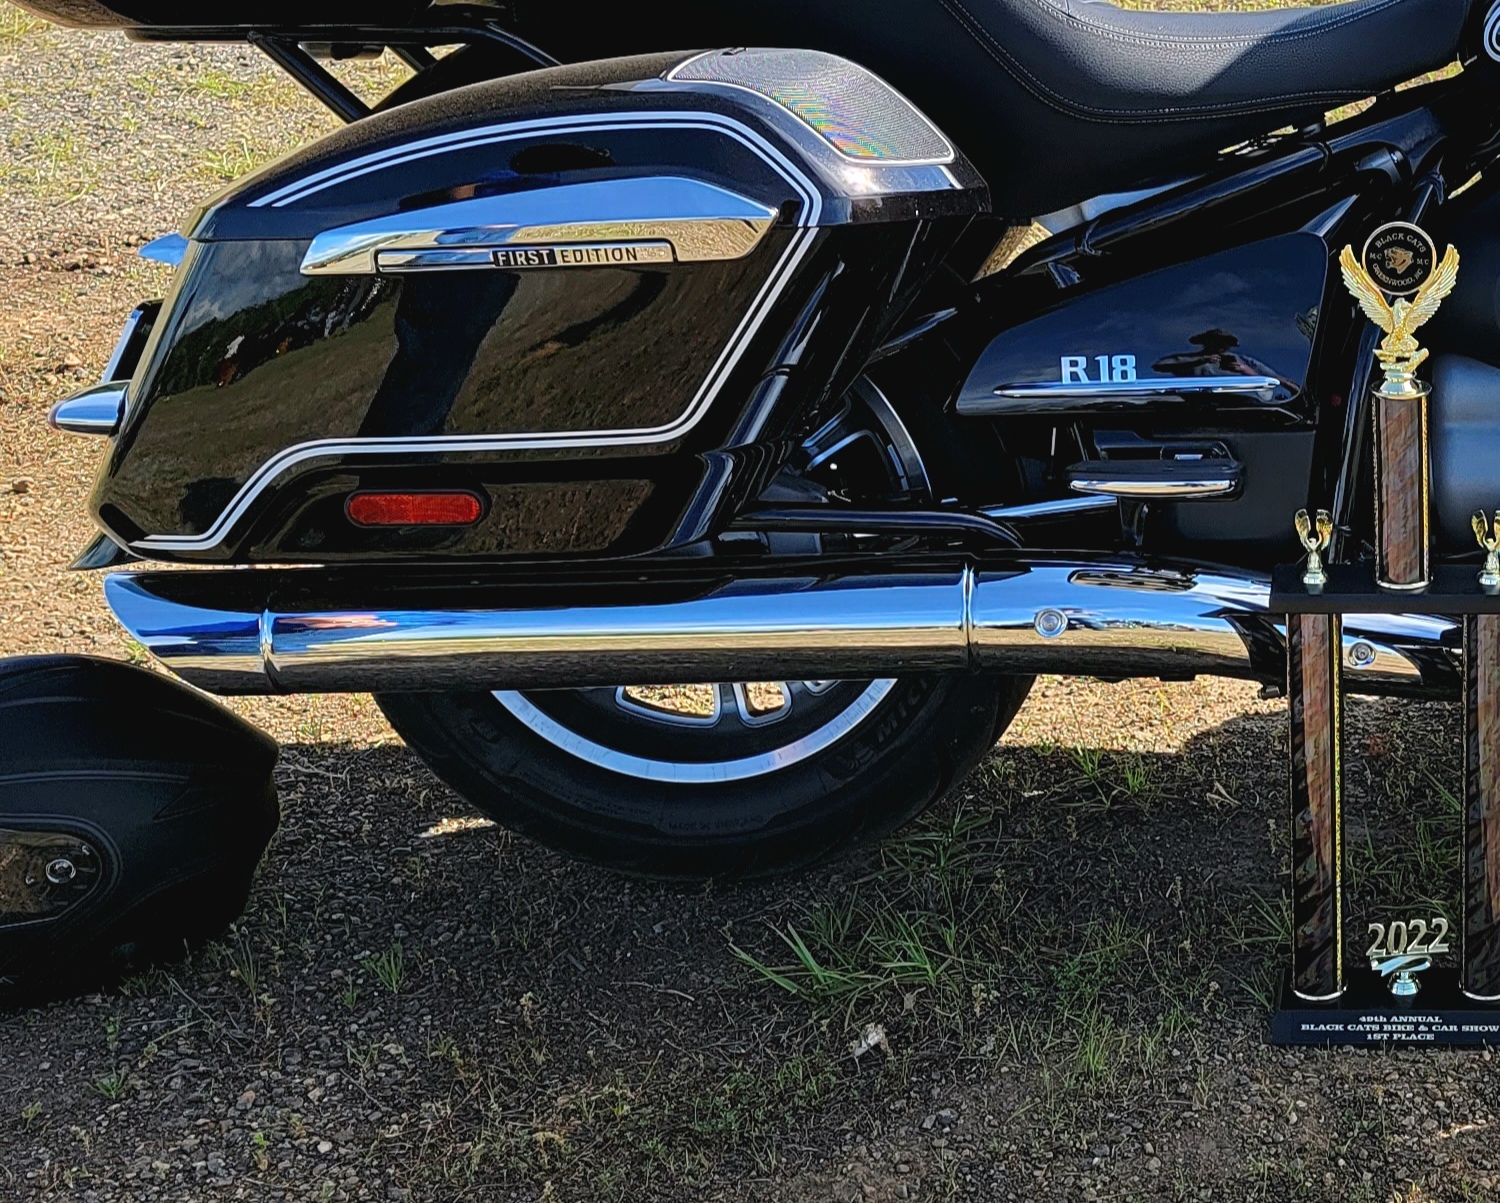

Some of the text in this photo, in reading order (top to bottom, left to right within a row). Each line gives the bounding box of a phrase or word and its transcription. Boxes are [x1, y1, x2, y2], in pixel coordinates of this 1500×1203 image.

[1375, 233, 1427, 253] BLACK CATS
[496, 247, 638, 266] FIRST EDITION
[1366, 917, 1449, 956] 2022
[1347, 1024, 1380, 1032] CATS
[1383, 1024, 1414, 1032] BIKE
[1461, 1024, 1500, 1032] SHOW
[1358, 1015, 1442, 1023] 49th ANNUAL
